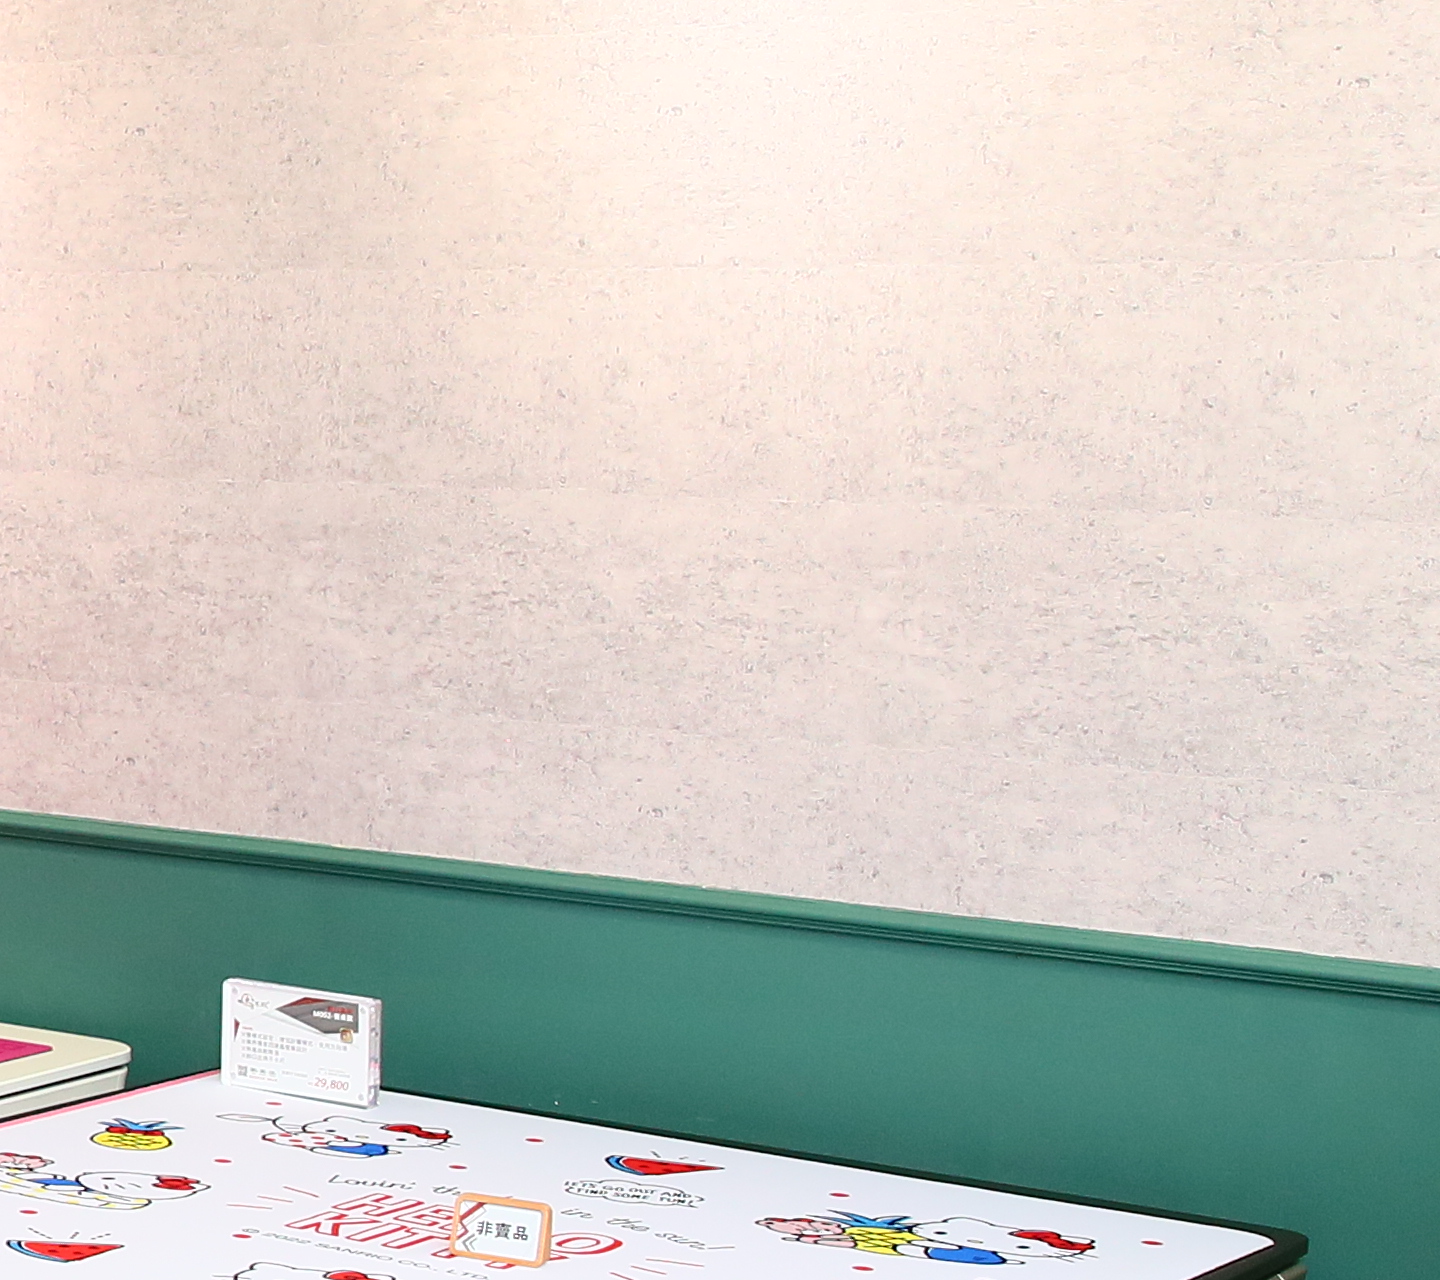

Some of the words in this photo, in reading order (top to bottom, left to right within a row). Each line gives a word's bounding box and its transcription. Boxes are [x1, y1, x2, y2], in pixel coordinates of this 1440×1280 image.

[313, 1076, 350, 1091] 29,800
[432, 1185, 462, 1196] th
[476, 1220, 529, 1241] 非賣品
[314, 1242, 394, 1261] SANRIO
